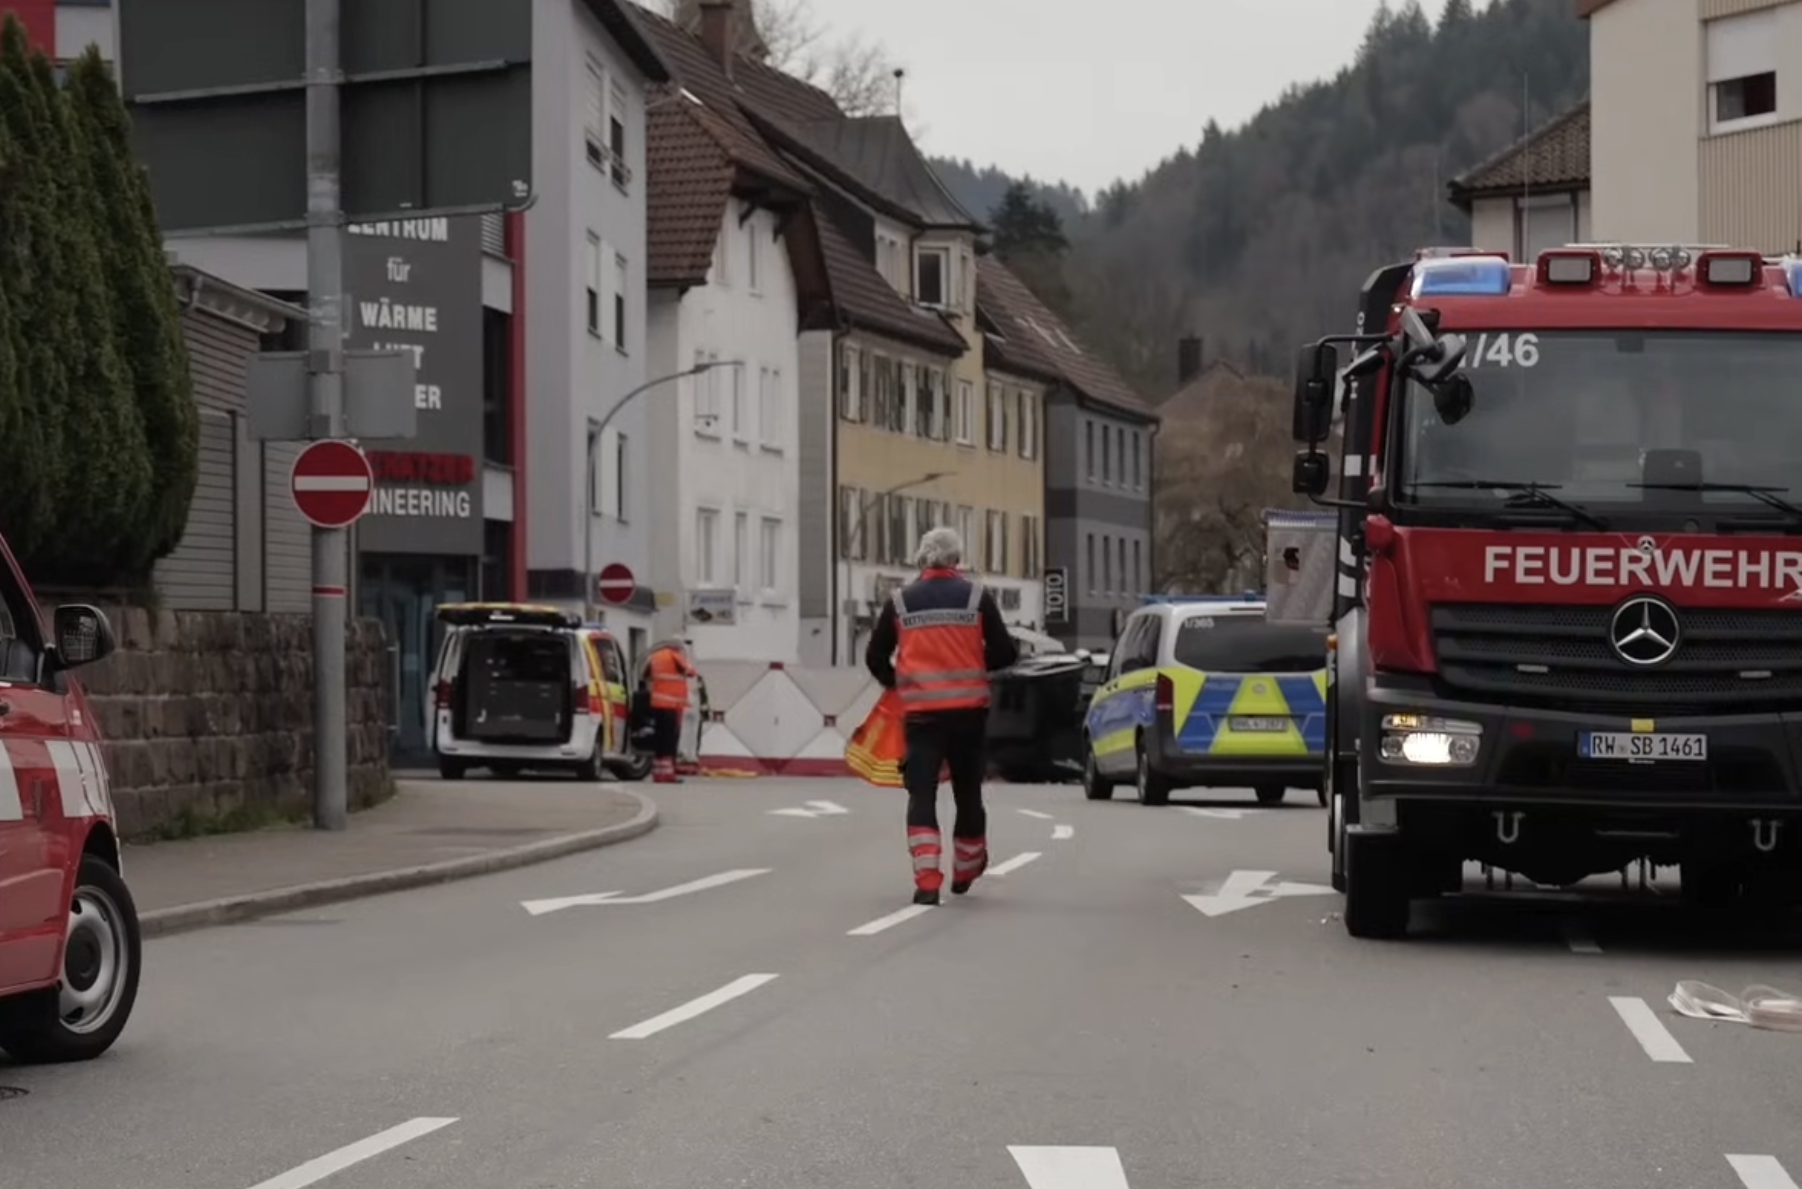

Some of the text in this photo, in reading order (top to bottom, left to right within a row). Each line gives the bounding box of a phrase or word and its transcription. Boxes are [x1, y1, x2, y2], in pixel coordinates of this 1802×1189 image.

[387, 256, 411, 282] für
[360, 298, 437, 331] WÄRME
[1484, 546, 1802, 588] FEUERWEHR
[1046, 573, 1063, 615] TOTO
[1592, 735, 1704, 757] RW SB 1461
